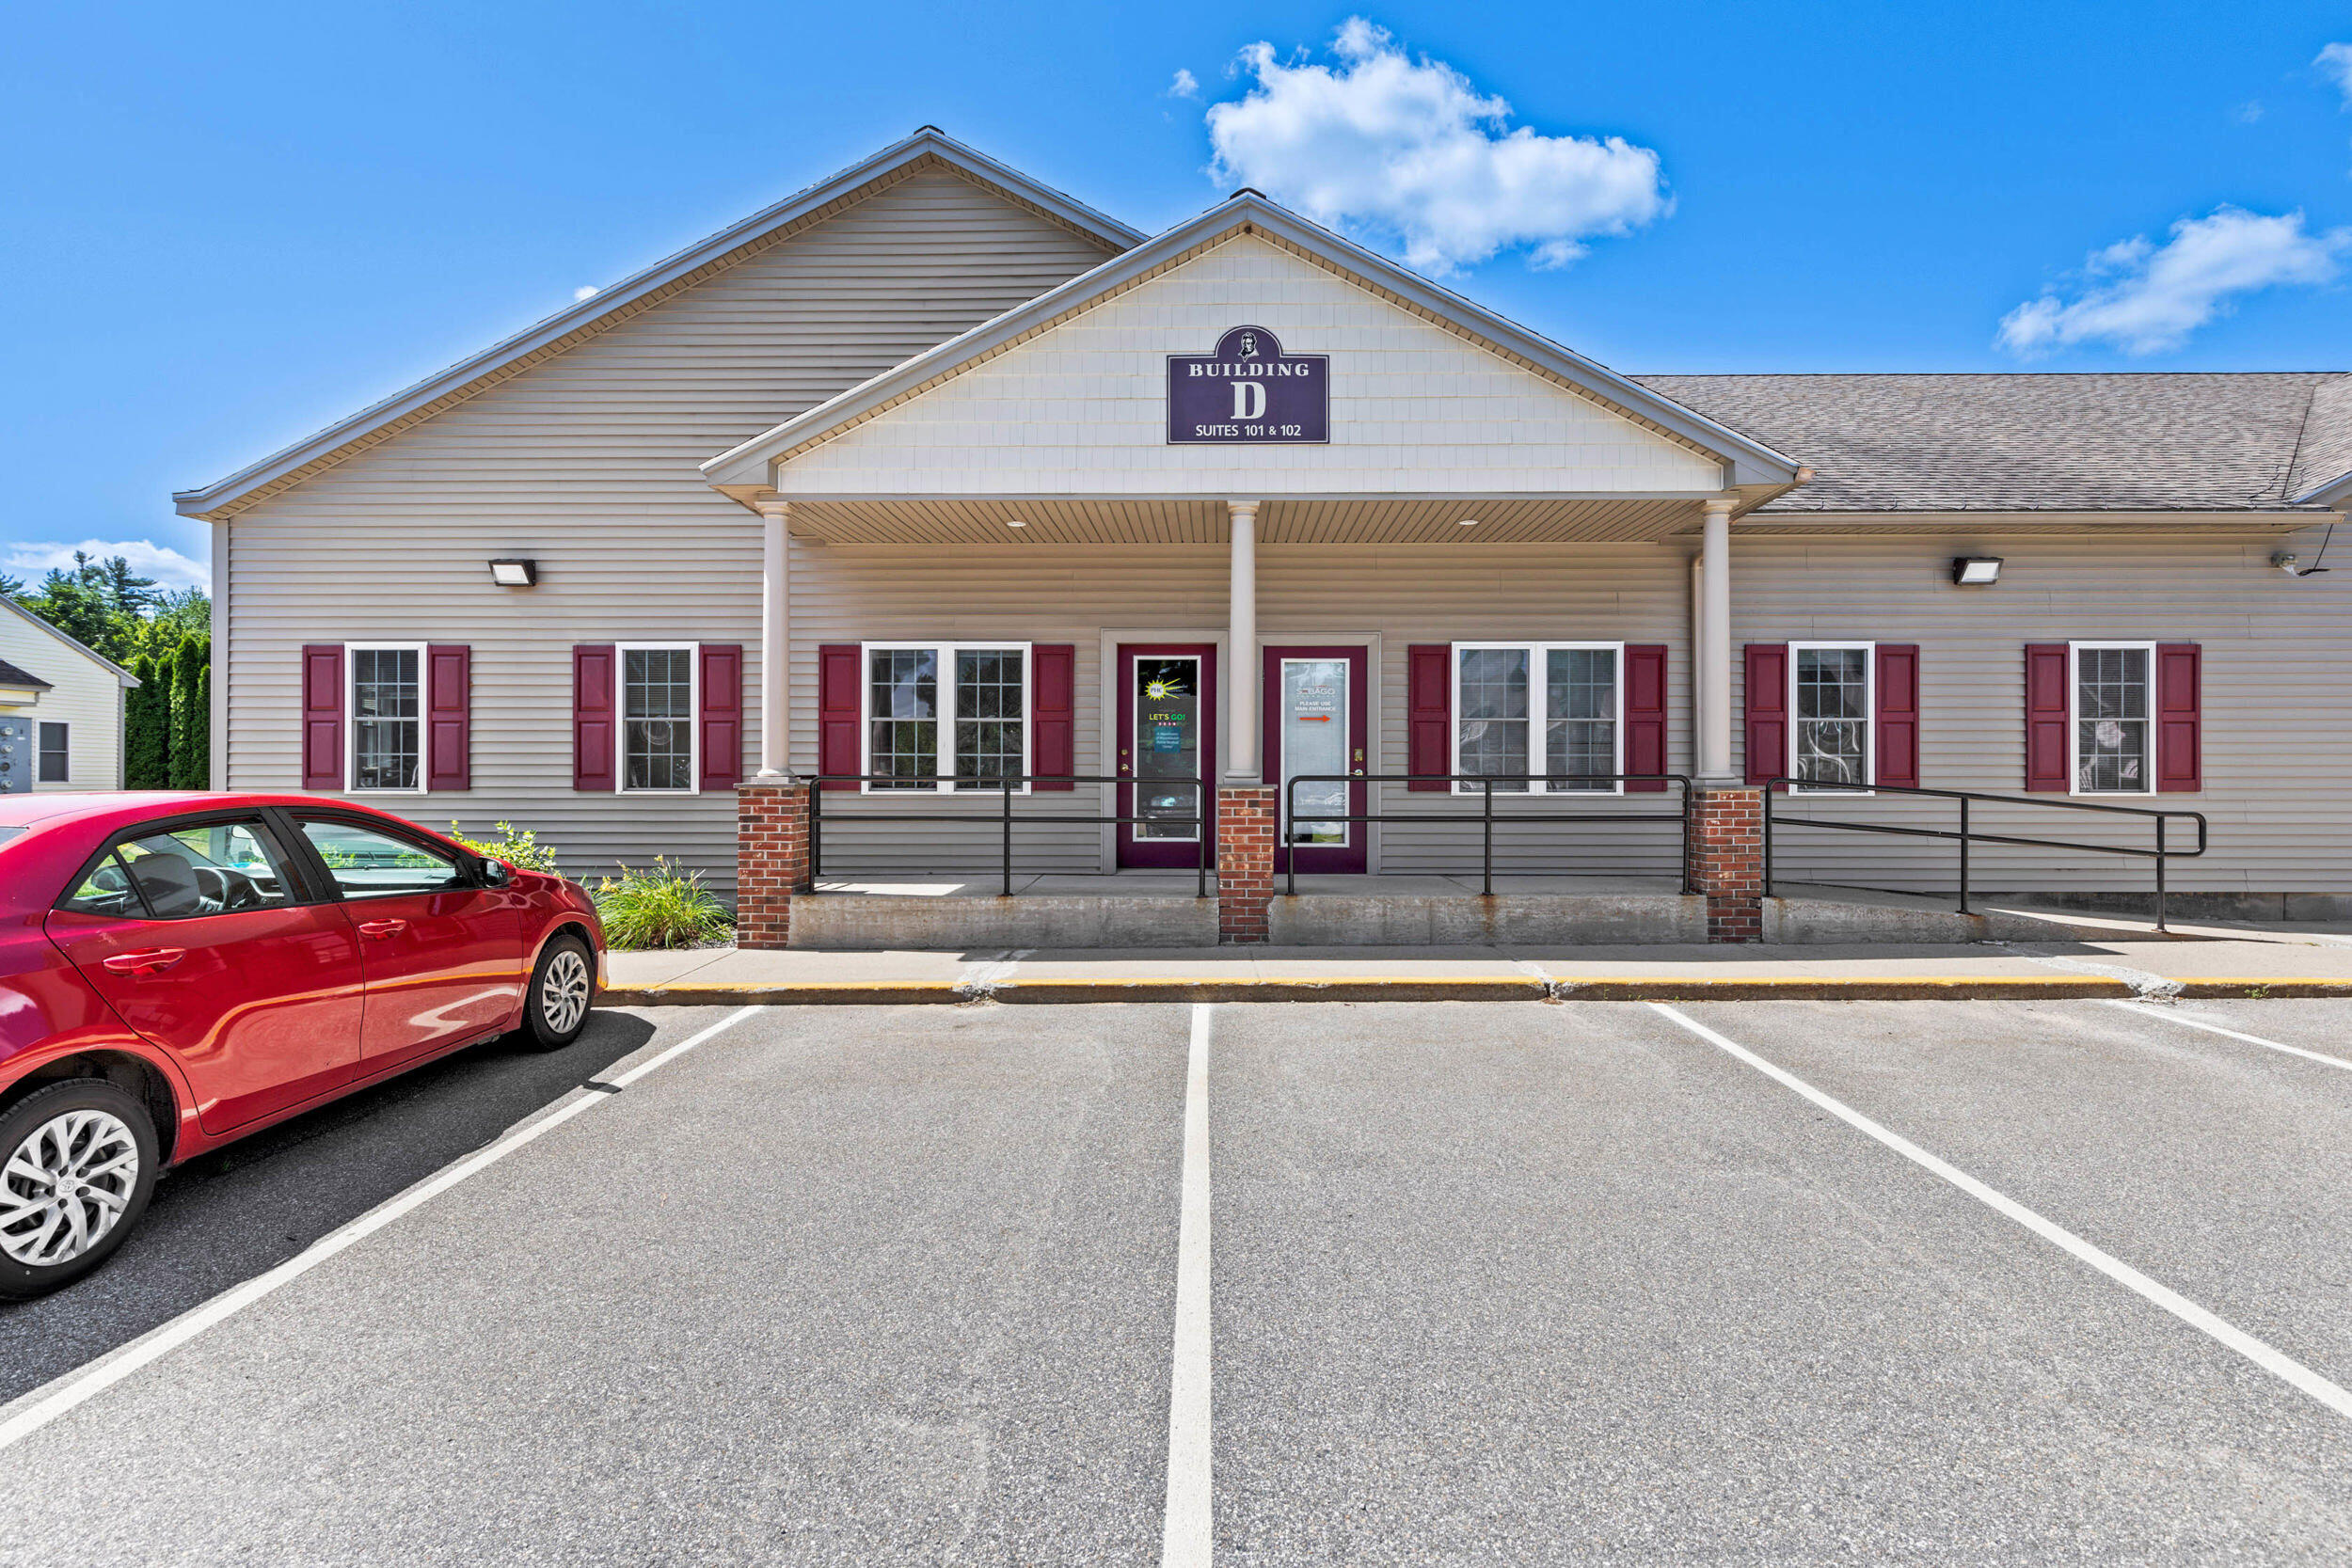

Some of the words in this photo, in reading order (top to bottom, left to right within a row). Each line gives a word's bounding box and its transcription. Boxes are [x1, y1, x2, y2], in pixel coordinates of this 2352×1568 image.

[1189, 363, 1310, 376] BUILDING
[1231, 381, 1266, 420] D
[1196, 424, 1239, 436] SUITES
[1245, 424, 1264, 436] 101
[1268, 425, 1277, 436] &
[1280, 424, 1301, 436] 102
